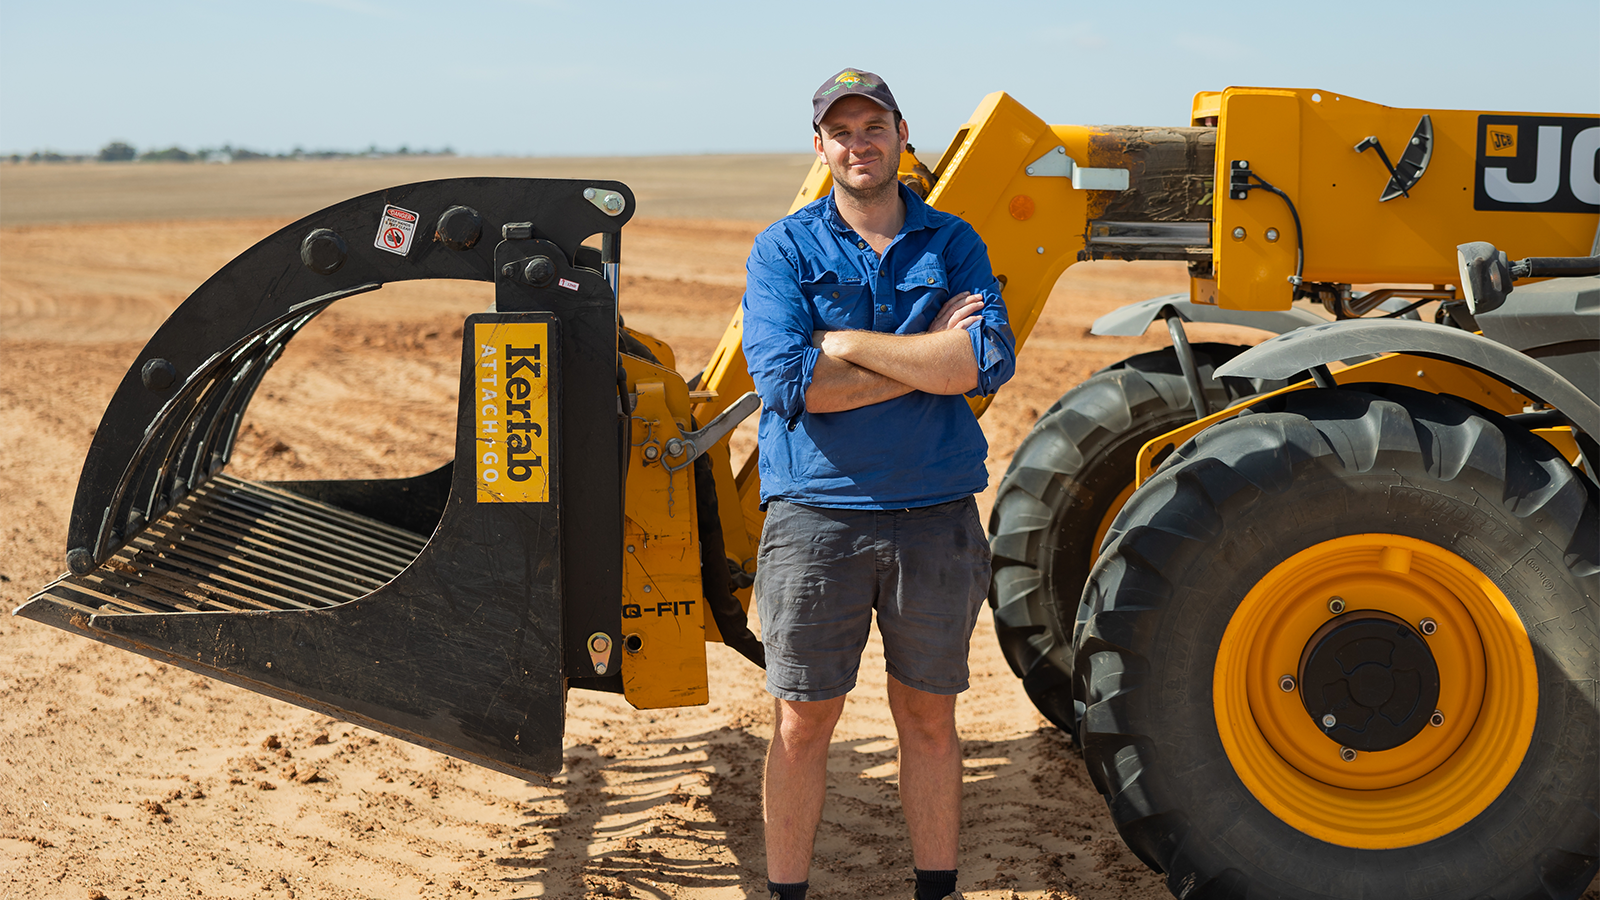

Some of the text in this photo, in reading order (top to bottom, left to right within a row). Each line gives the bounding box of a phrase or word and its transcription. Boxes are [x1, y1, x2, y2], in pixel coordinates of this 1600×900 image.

[1494, 133, 1513, 148] JCB
[390, 210, 411, 220] DANGER
[505, 343, 542, 482] Kerfab
[622, 600, 696, 619] Q-FIT
